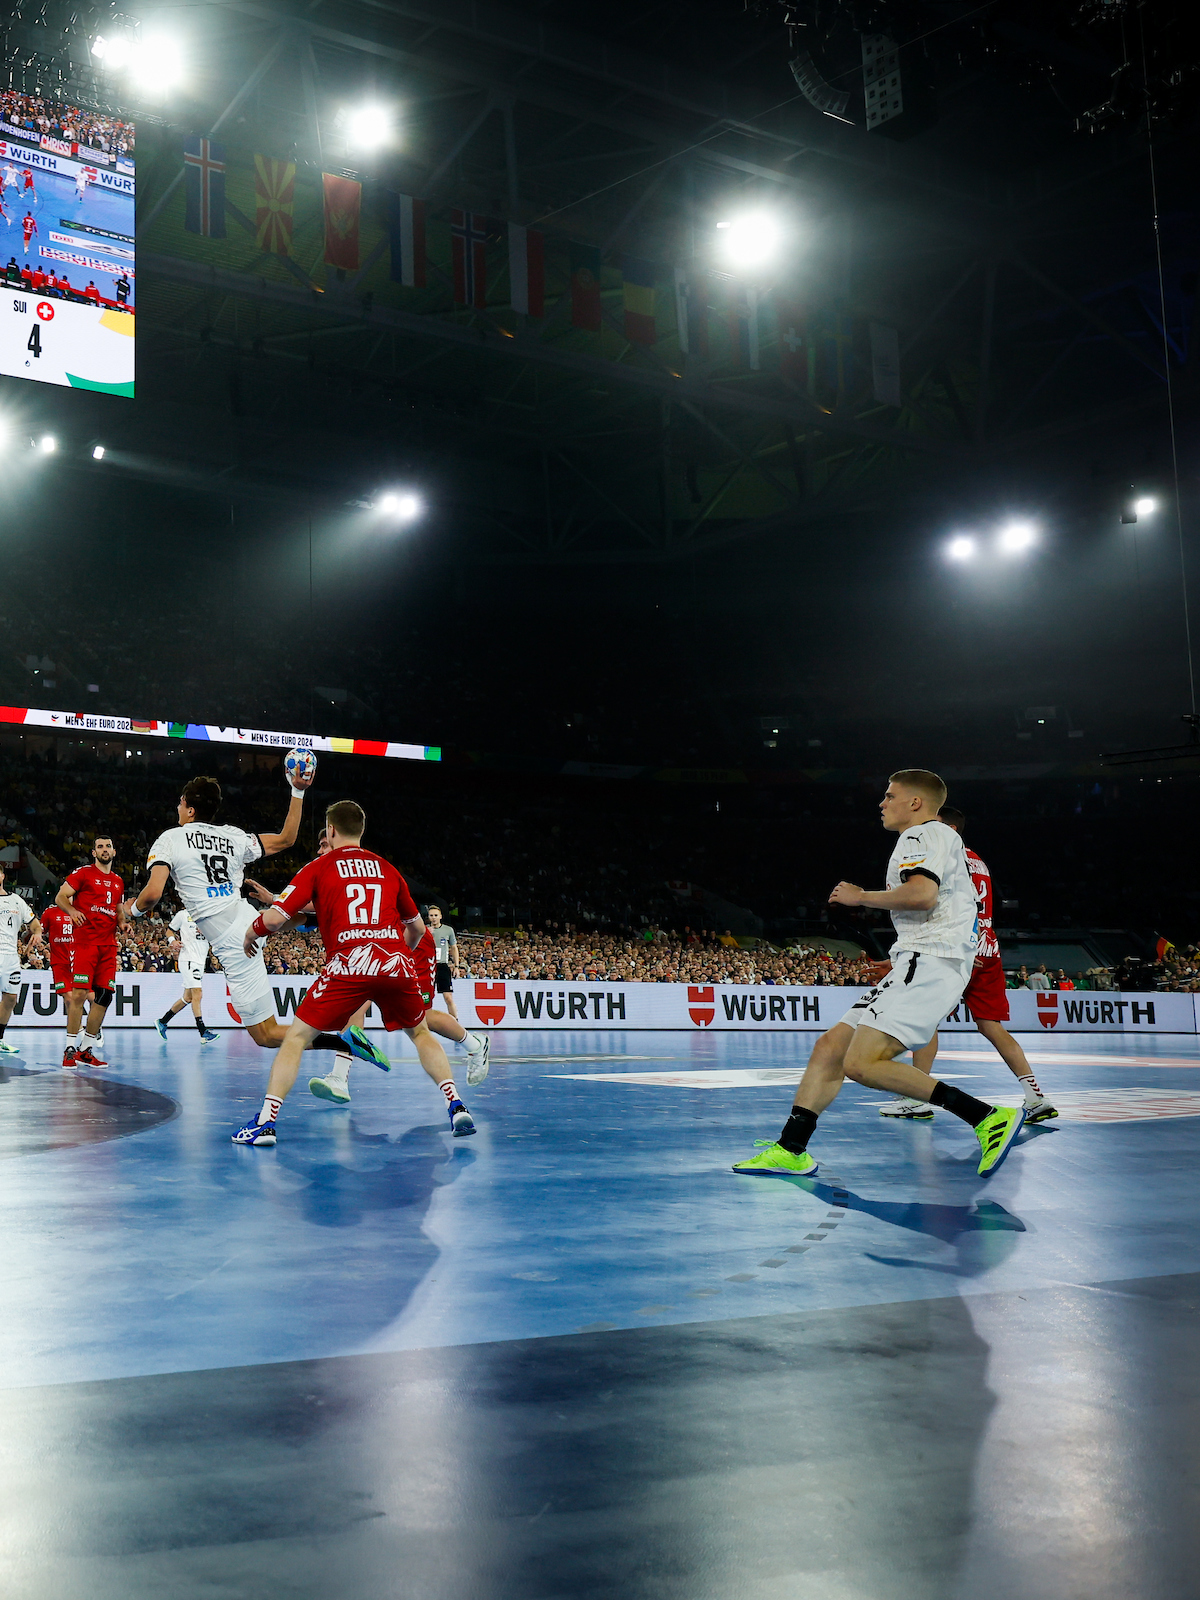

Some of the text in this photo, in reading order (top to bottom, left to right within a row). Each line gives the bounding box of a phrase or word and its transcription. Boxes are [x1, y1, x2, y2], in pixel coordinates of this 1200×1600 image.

[101, 172, 135, 192] WÜR
[13, 300, 27, 314] SUI
[28, 323, 42, 358] 4
[86, 718, 98, 728] EHF
[99, 719, 115, 729] EURO
[281, 735, 296, 746] EURO
[297, 737, 313, 747] 2024
[185, 830, 235, 857] KÖSTER
[201, 853, 229, 885] 18
[335, 859, 385, 879] GERBL
[106, 891, 112, 904] 3
[345, 883, 382, 925] 27
[7, 916, 13, 928] 4
[62, 923, 72, 935] 29
[514, 990, 626, 1021] WÜRTH
[722, 994, 820, 1023] WÜRTH
[1063, 1000, 1156, 1025] WÜRTH
